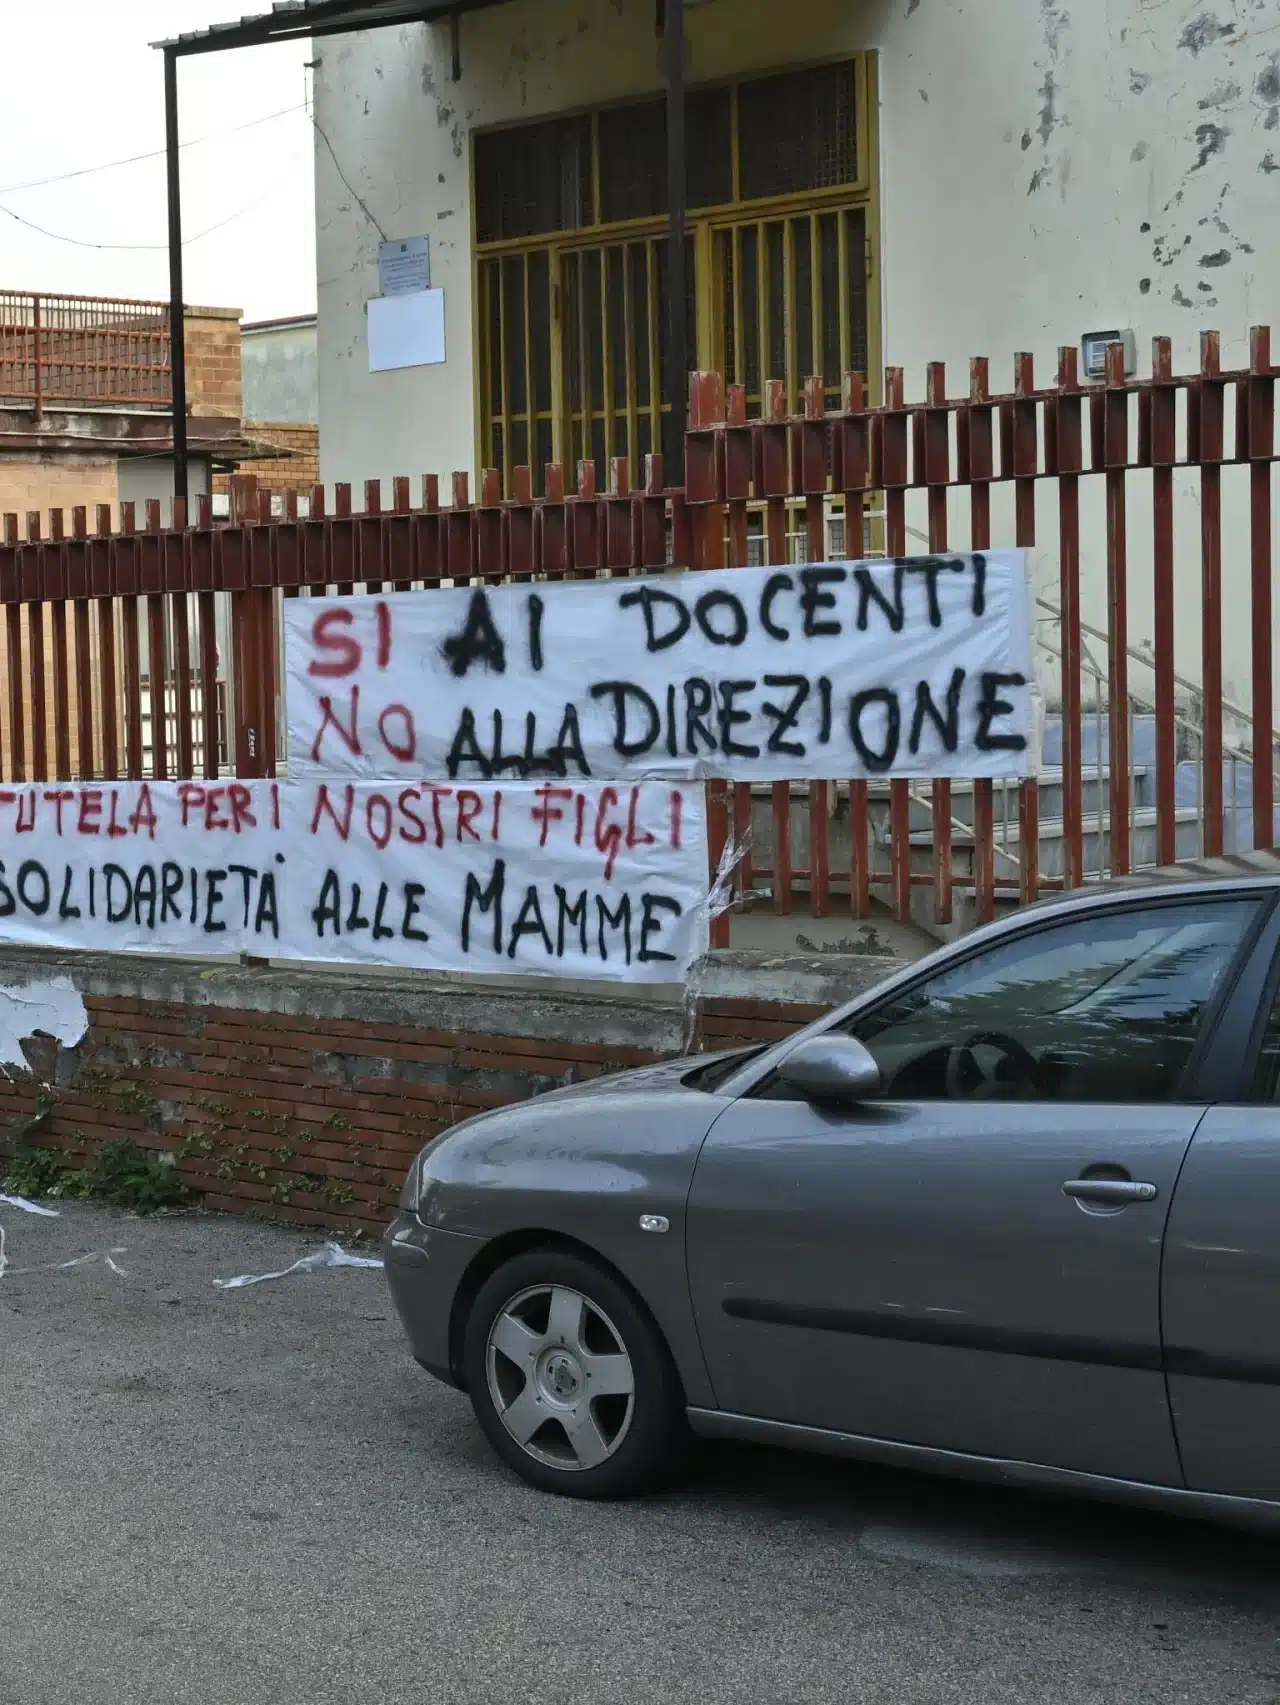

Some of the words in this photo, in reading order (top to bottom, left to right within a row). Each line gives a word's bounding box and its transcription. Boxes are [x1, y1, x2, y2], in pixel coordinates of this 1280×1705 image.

[307, 601, 392, 678] SI
[440, 586, 545, 678] AI
[620, 553, 987, 653] DOCENTI
[311, 684, 417, 763] NO
[445, 703, 592, 779] ALLA
[589, 667, 1027, 772] DIREZIONE
[177, 783, 257, 835] PER
[271, 783, 281, 830] I
[309, 781, 502, 850] NOSTRI
[530, 781, 683, 880] FIGLI
[311, 868, 429, 942] ALLE
[461, 858, 683, 966] MAMME
